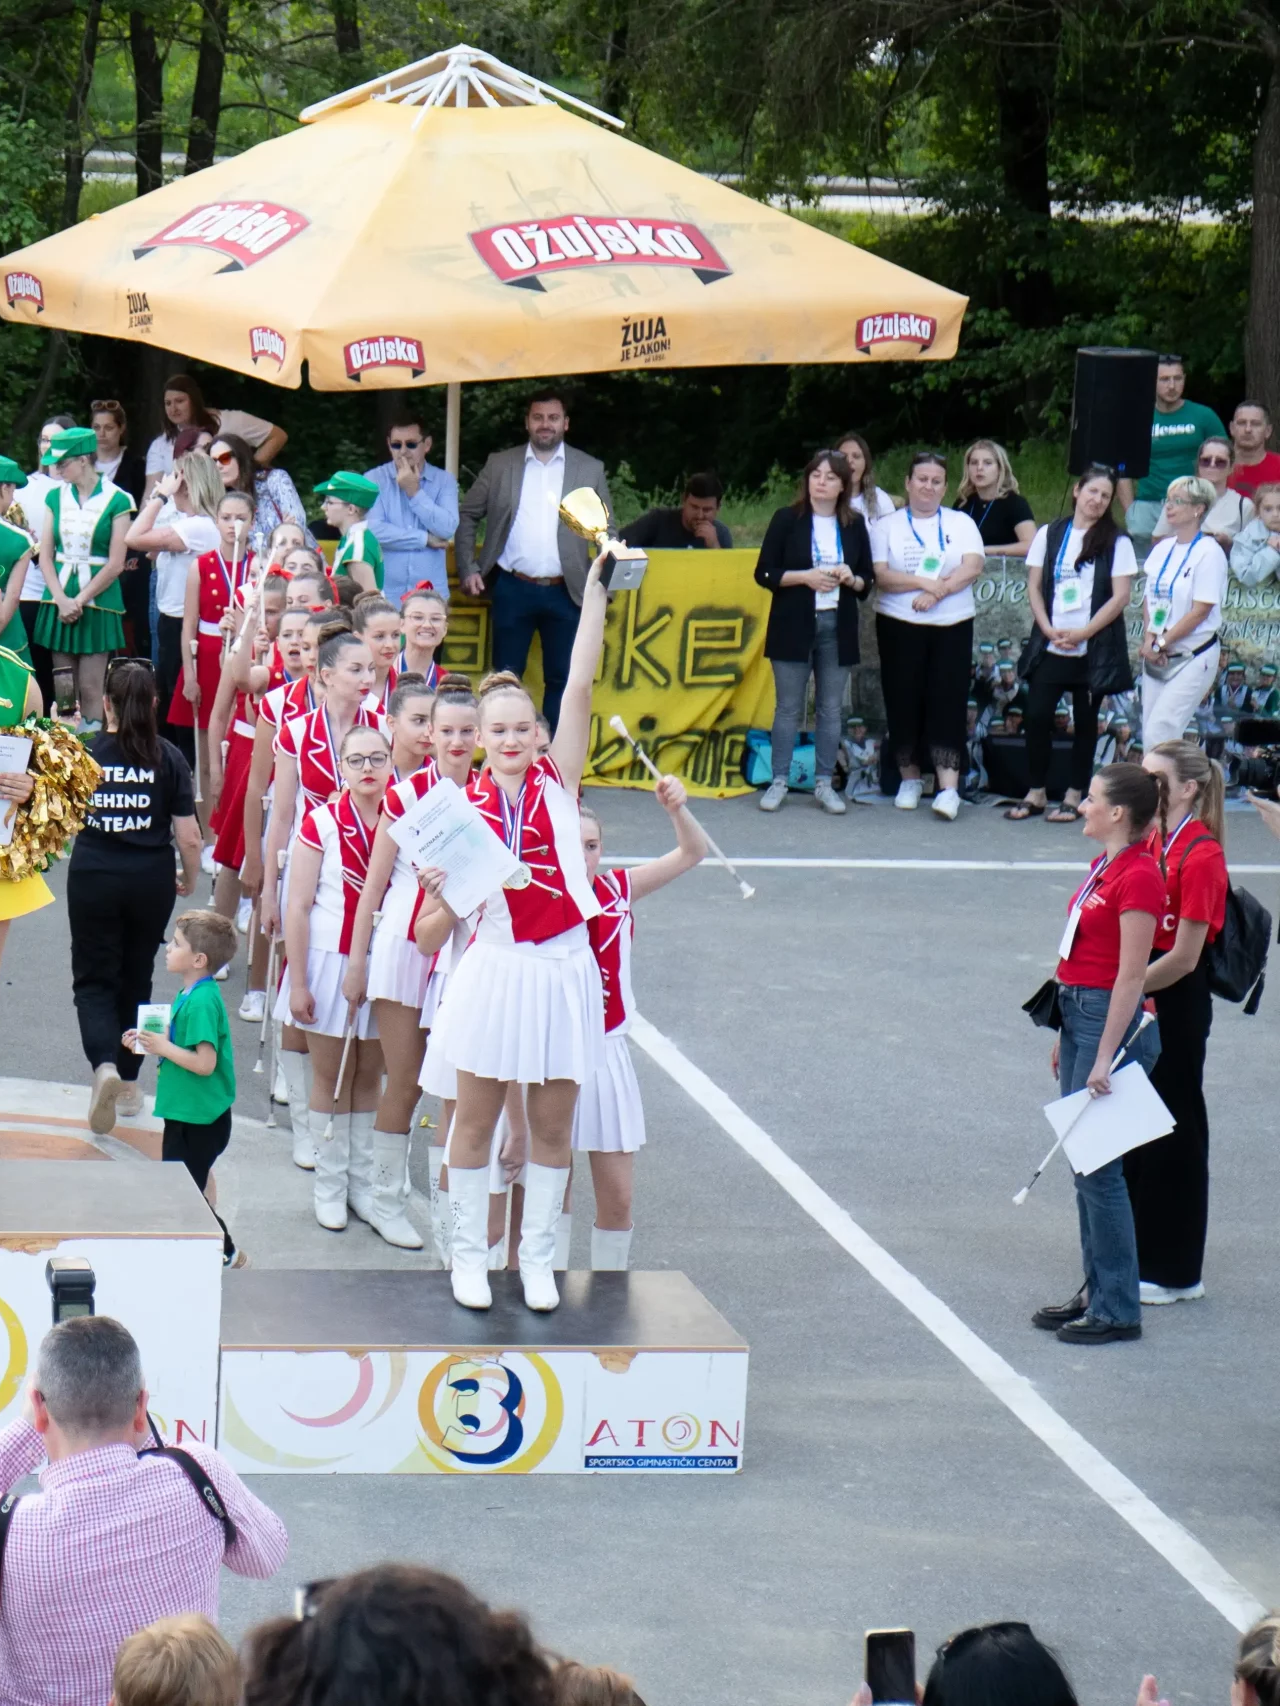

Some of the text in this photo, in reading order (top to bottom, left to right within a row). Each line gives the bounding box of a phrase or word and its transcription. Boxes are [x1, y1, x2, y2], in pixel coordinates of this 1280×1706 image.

[162, 202, 293, 255] Ožujsko
[490, 215, 704, 271] Ožujsko
[7, 273, 42, 301] Ožujsko
[126, 288, 151, 314] ŽUJA
[621, 315, 667, 348] ŽUJA
[862, 313, 931, 343] Ožujsko
[252, 328, 285, 361] Ožujsko
[349, 337, 420, 370] Ožujsko
[620, 337, 671, 363] JE ZAKON!
[102, 766, 155, 783] TEAM
[102, 815, 152, 832] TEAM
[441, 1361, 524, 1465] 3
[585, 1412, 740, 1453] ATON
[588, 1456, 734, 1467] SPORTSKO GIMNASTIČKI CENTAR
[203, 1486, 226, 1518] Canon
